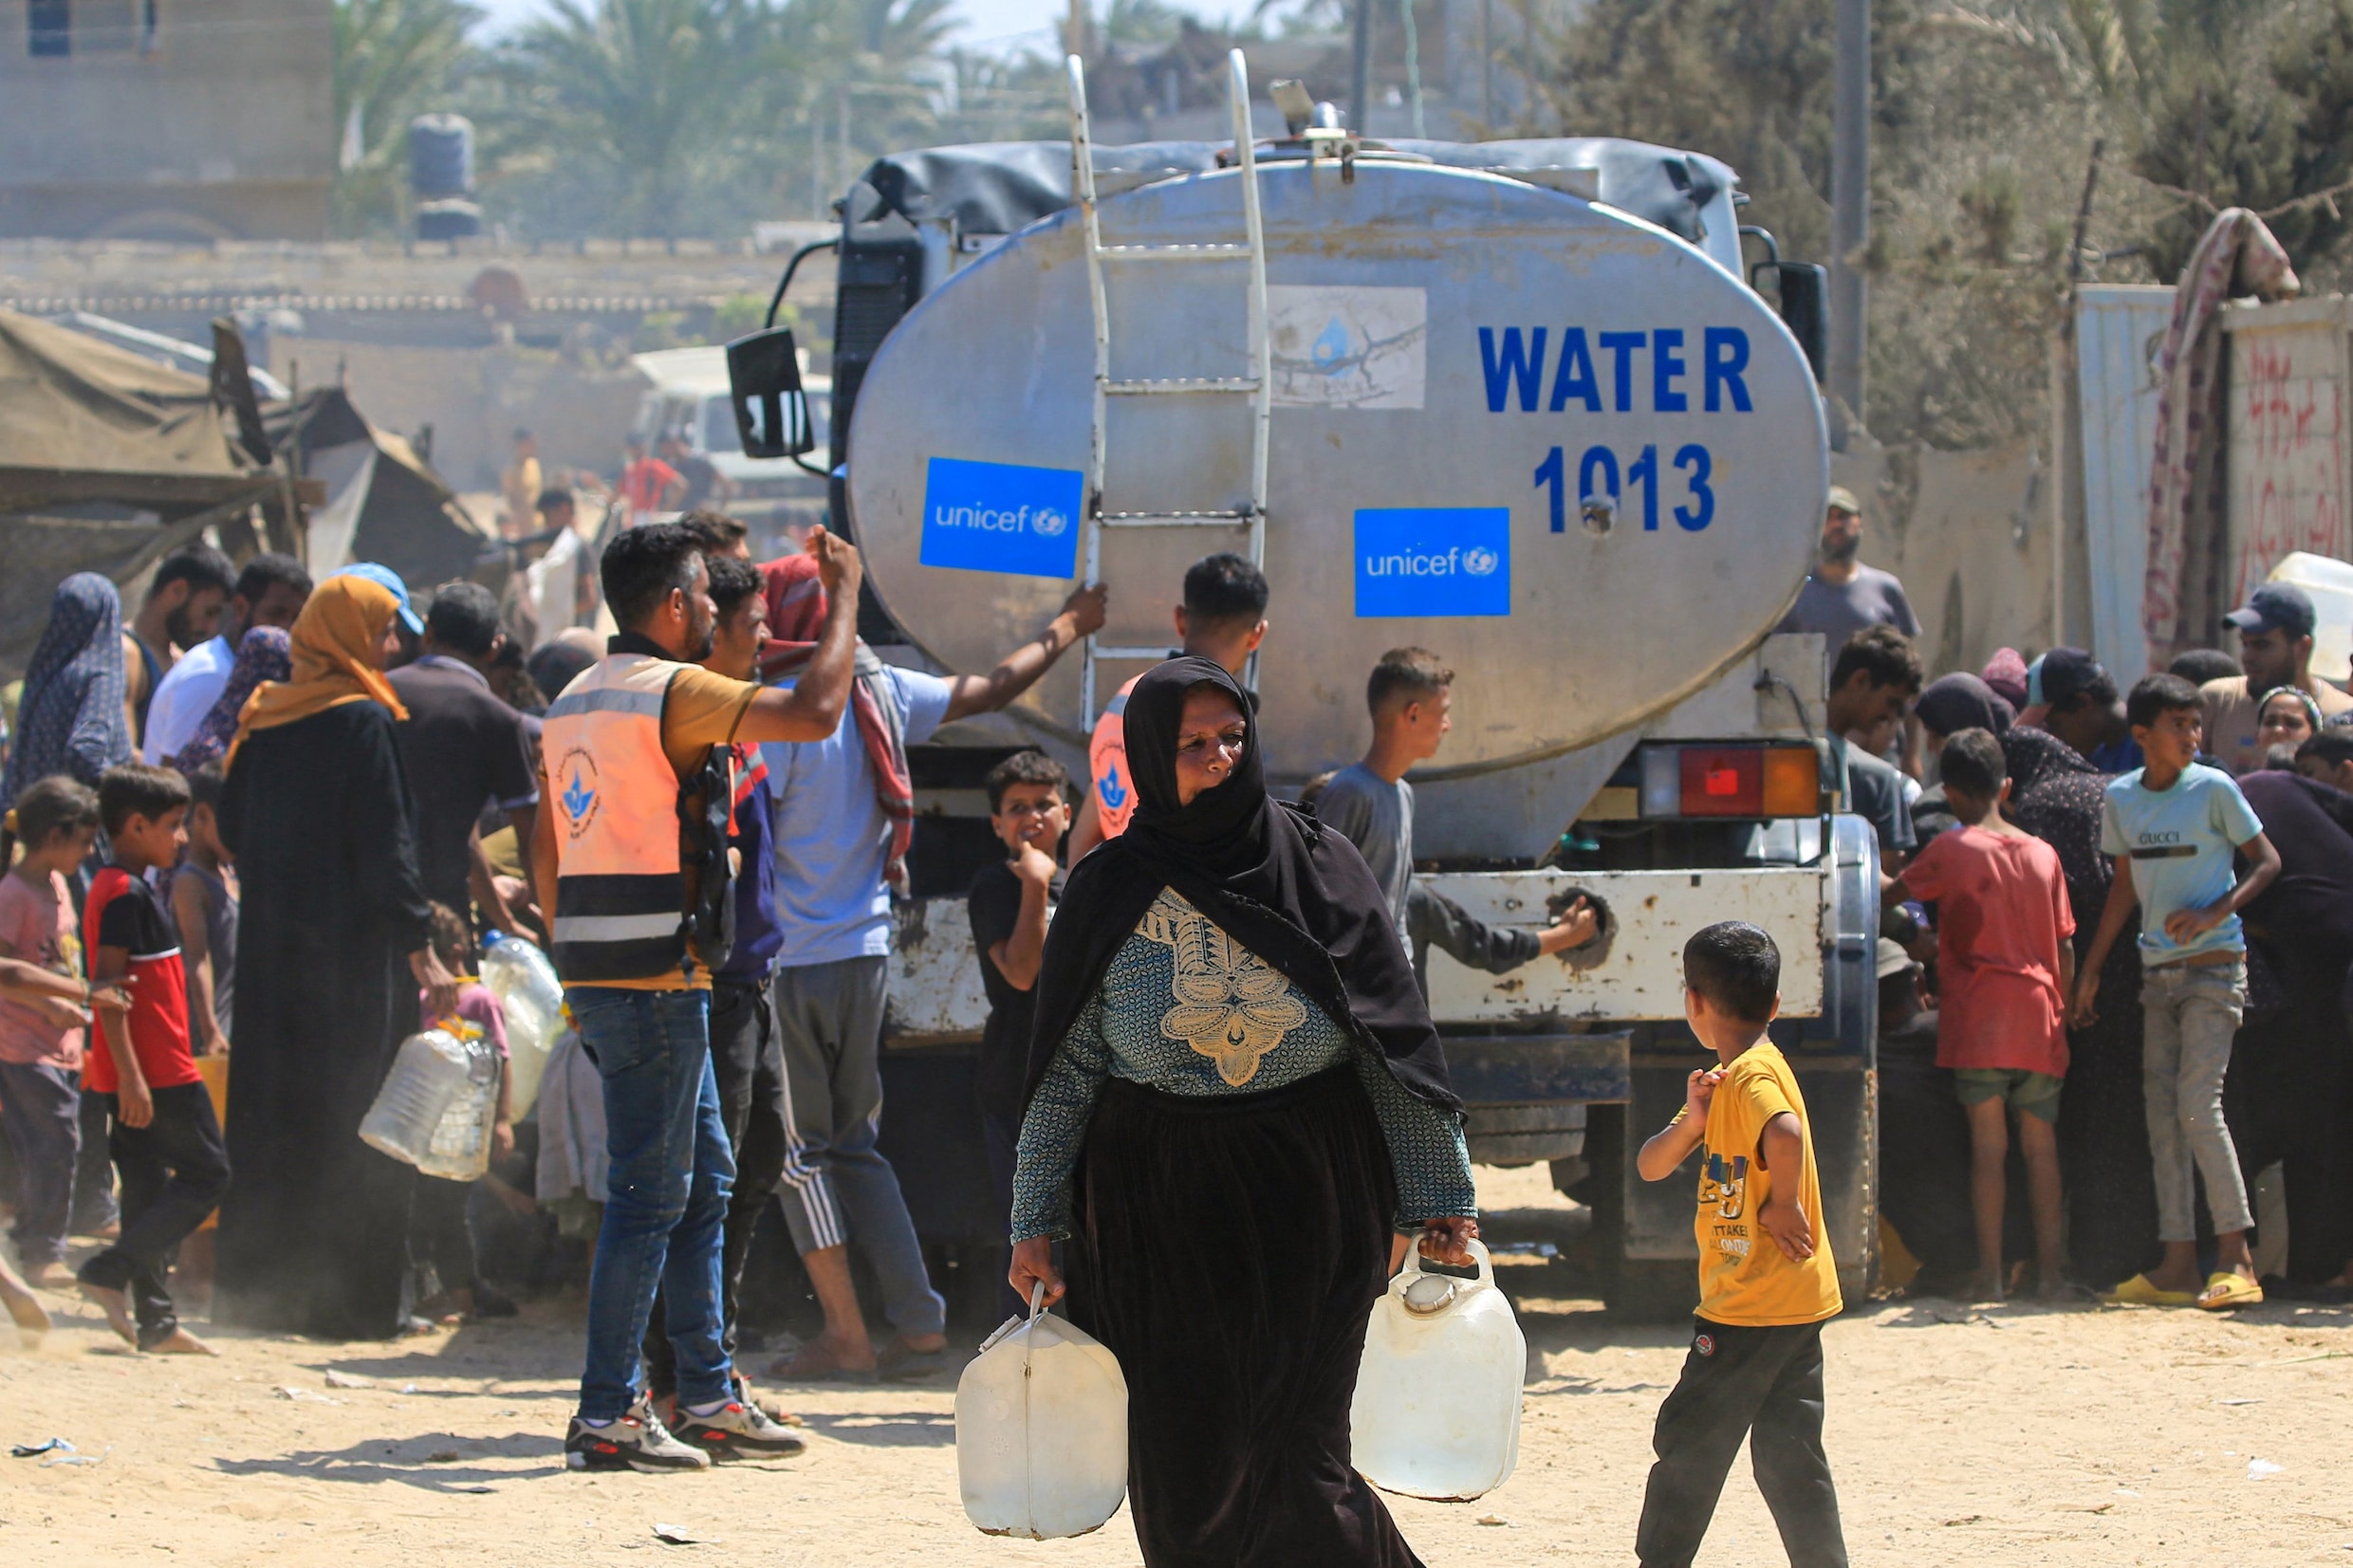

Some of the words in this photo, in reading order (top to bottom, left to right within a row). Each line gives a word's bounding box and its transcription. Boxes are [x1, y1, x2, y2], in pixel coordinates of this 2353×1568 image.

[1478, 326, 1754, 413] WATER
[1534, 443, 1715, 534] 1013
[935, 500, 1030, 533] unicef
[1366, 546, 1459, 577] unicef
[2139, 831, 2180, 844] GUCCI
